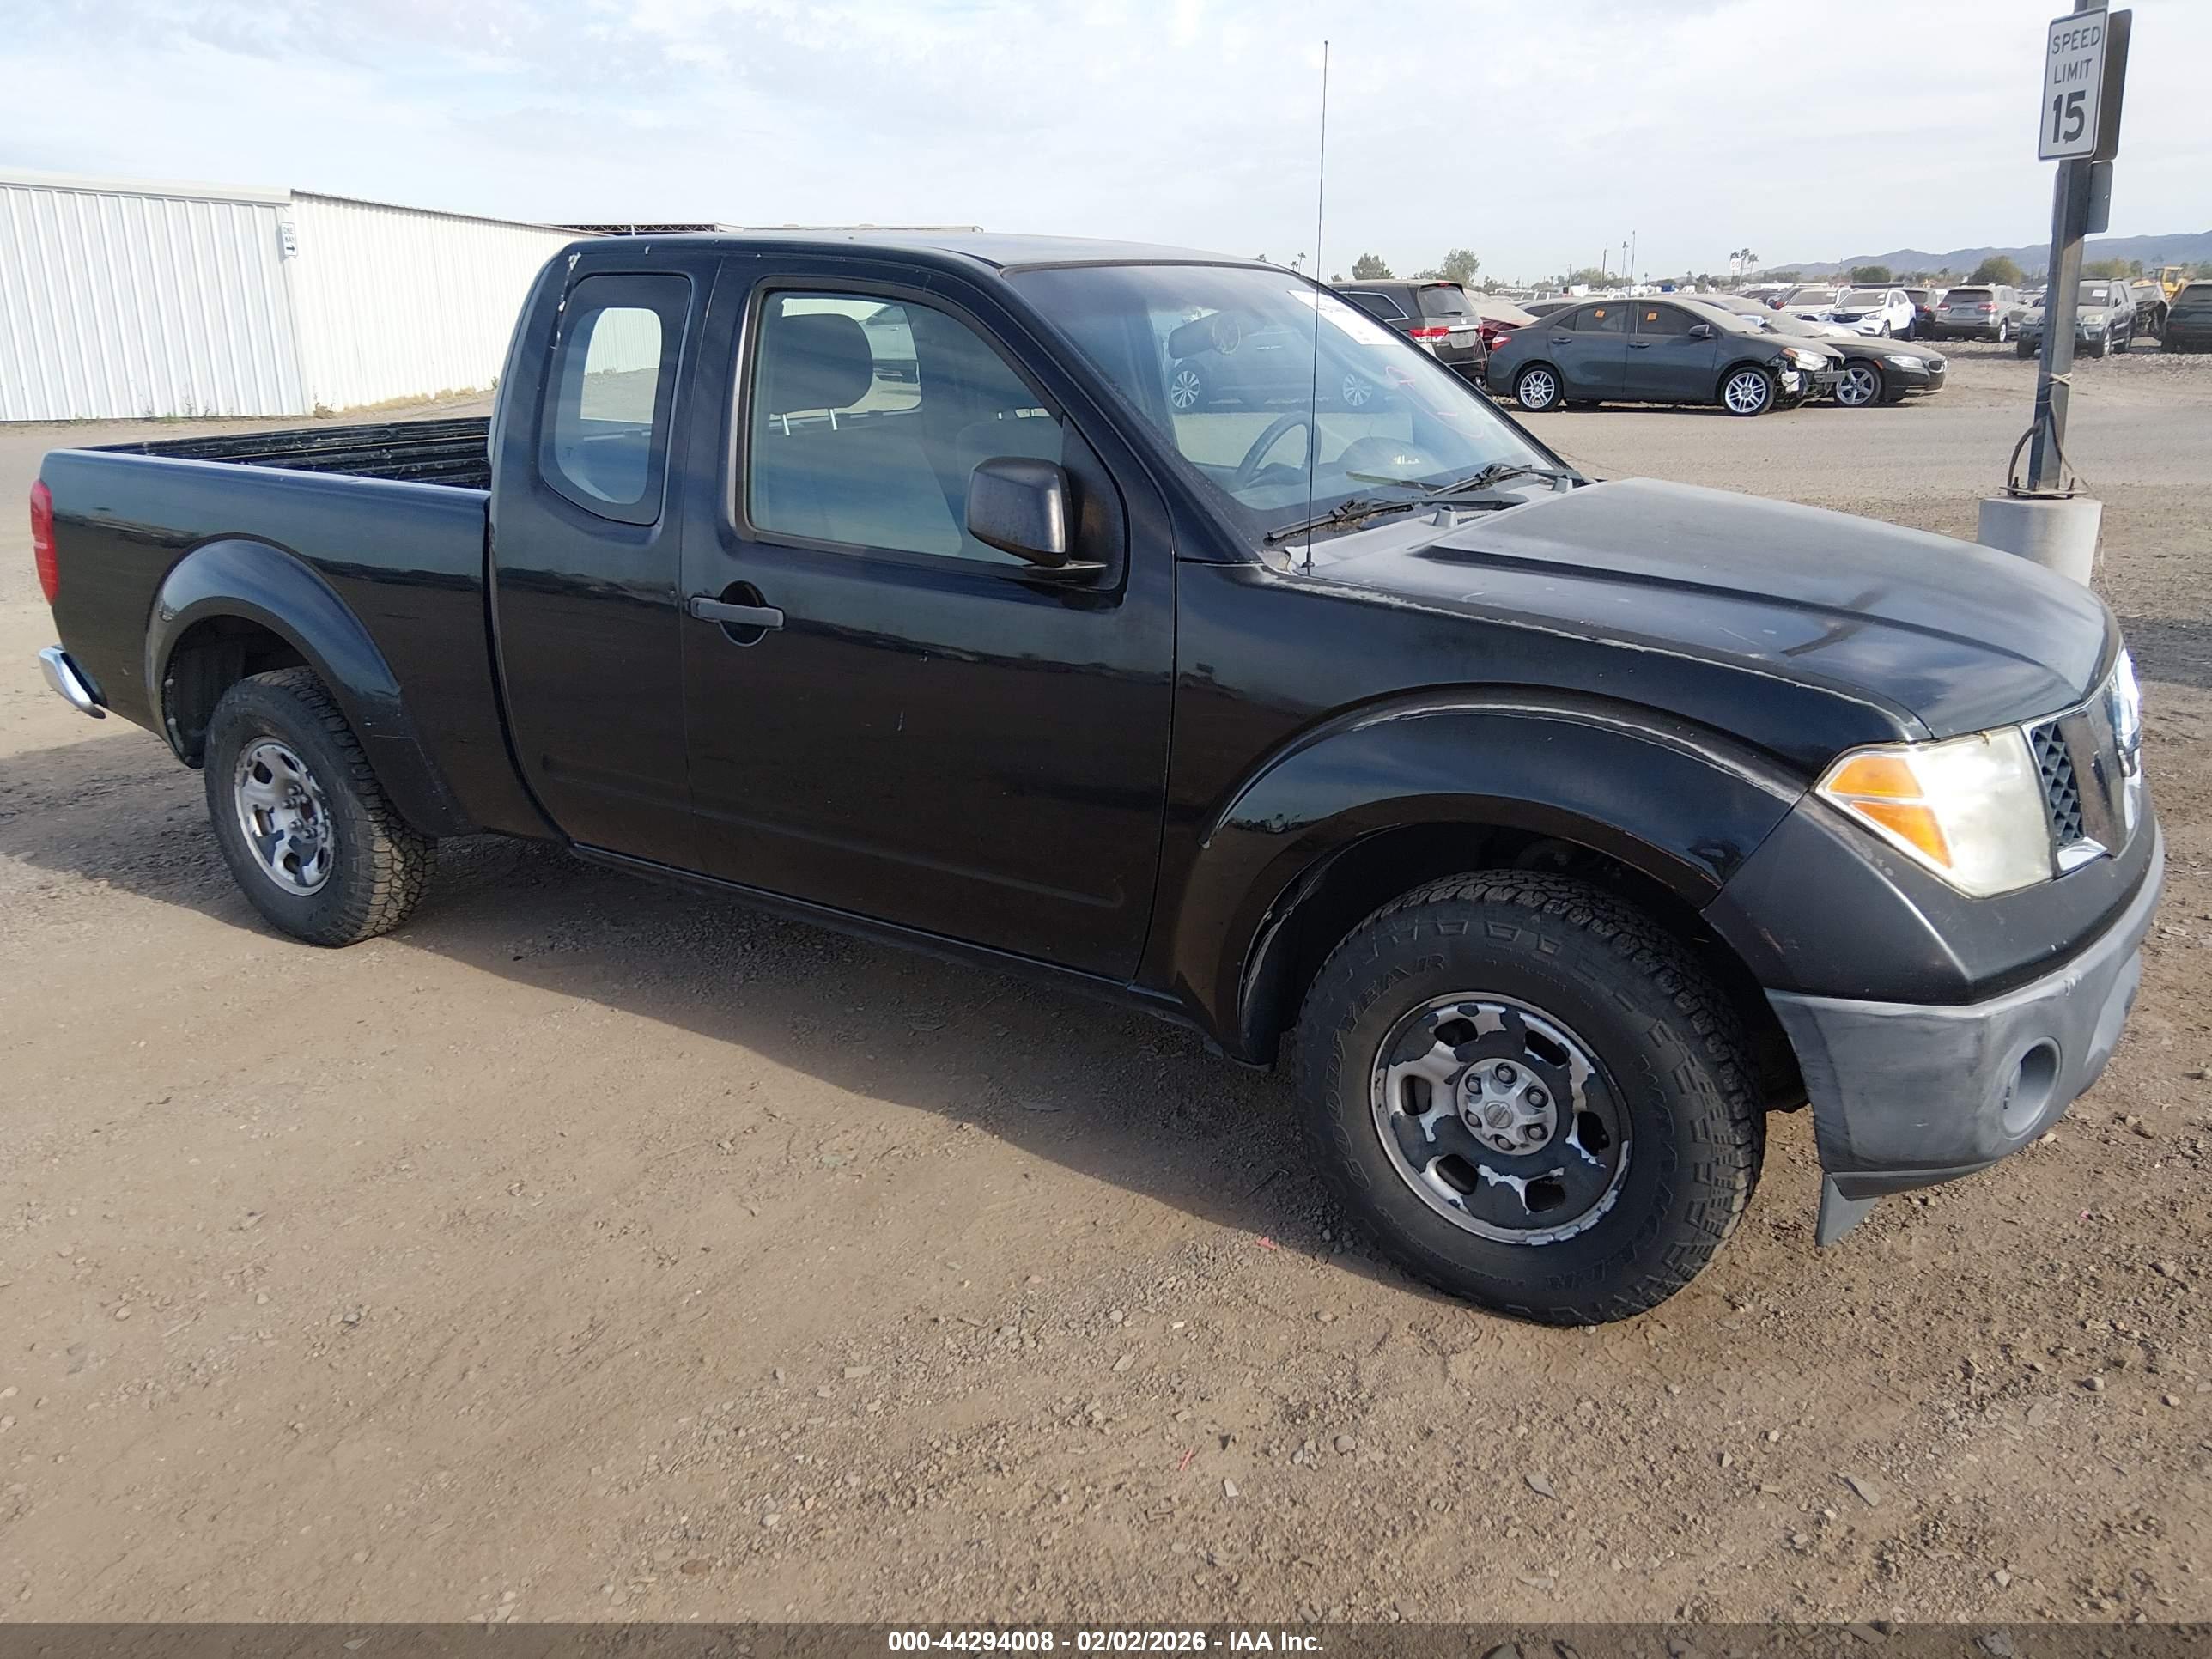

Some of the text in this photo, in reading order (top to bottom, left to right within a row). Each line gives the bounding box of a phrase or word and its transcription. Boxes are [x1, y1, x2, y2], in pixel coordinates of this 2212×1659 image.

[2051, 26, 2101, 55] SPEED
[2053, 58, 2093, 84] LIMIT
[2052, 89, 2087, 144] 15
